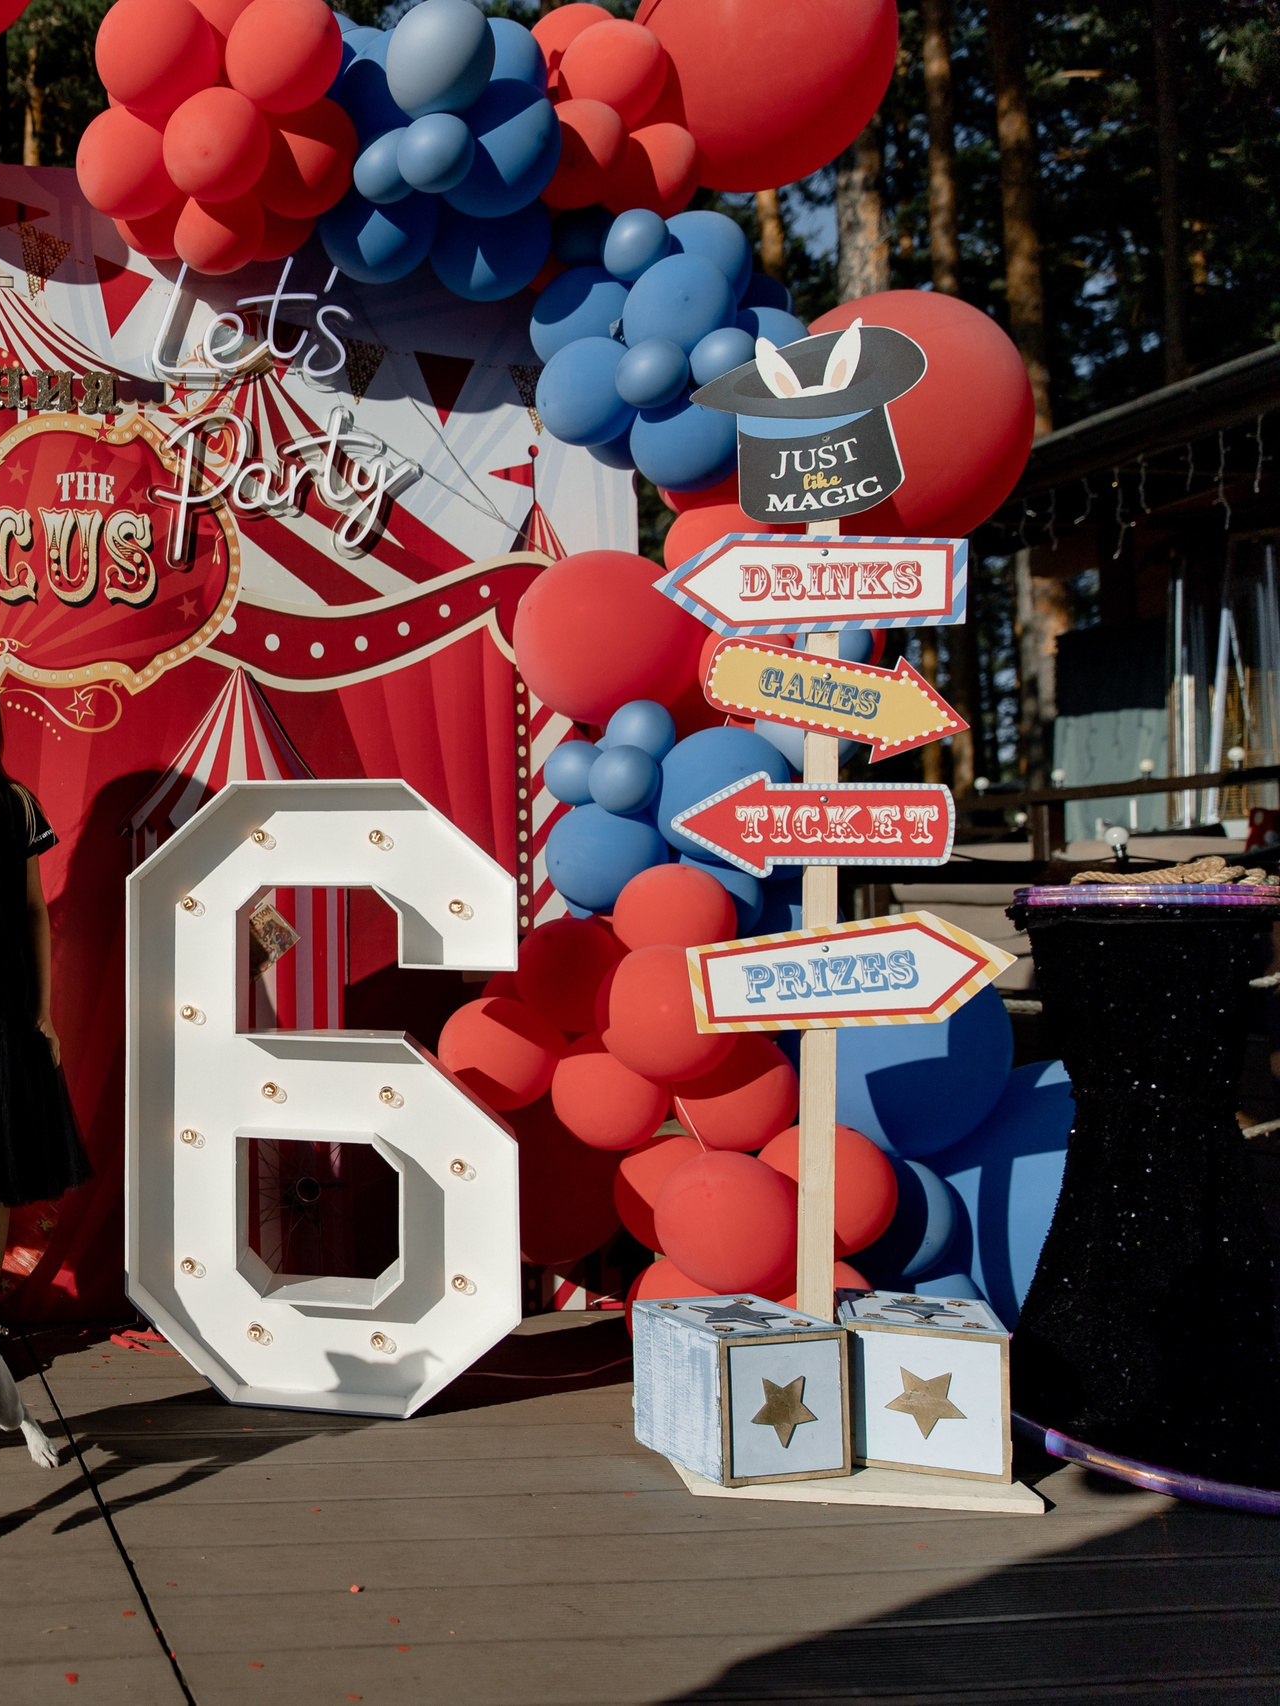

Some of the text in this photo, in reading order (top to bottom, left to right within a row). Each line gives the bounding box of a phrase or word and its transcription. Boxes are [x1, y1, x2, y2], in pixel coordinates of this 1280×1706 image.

[152, 256, 354, 377] Let's
[770, 437, 858, 480] JUST
[56, 471, 115, 504] THE
[155, 410, 413, 560] Party
[765, 476, 883, 512] MAGIC
[803, 471, 842, 491] like
[739, 561, 923, 602] DRINKS
[758, 666, 882, 720] GAMES
[734, 804, 940, 844] TICKET
[249, 904, 273, 928] ESSION
[741, 949, 918, 1004] PRIZES
[125, 778, 522, 1419] 6
